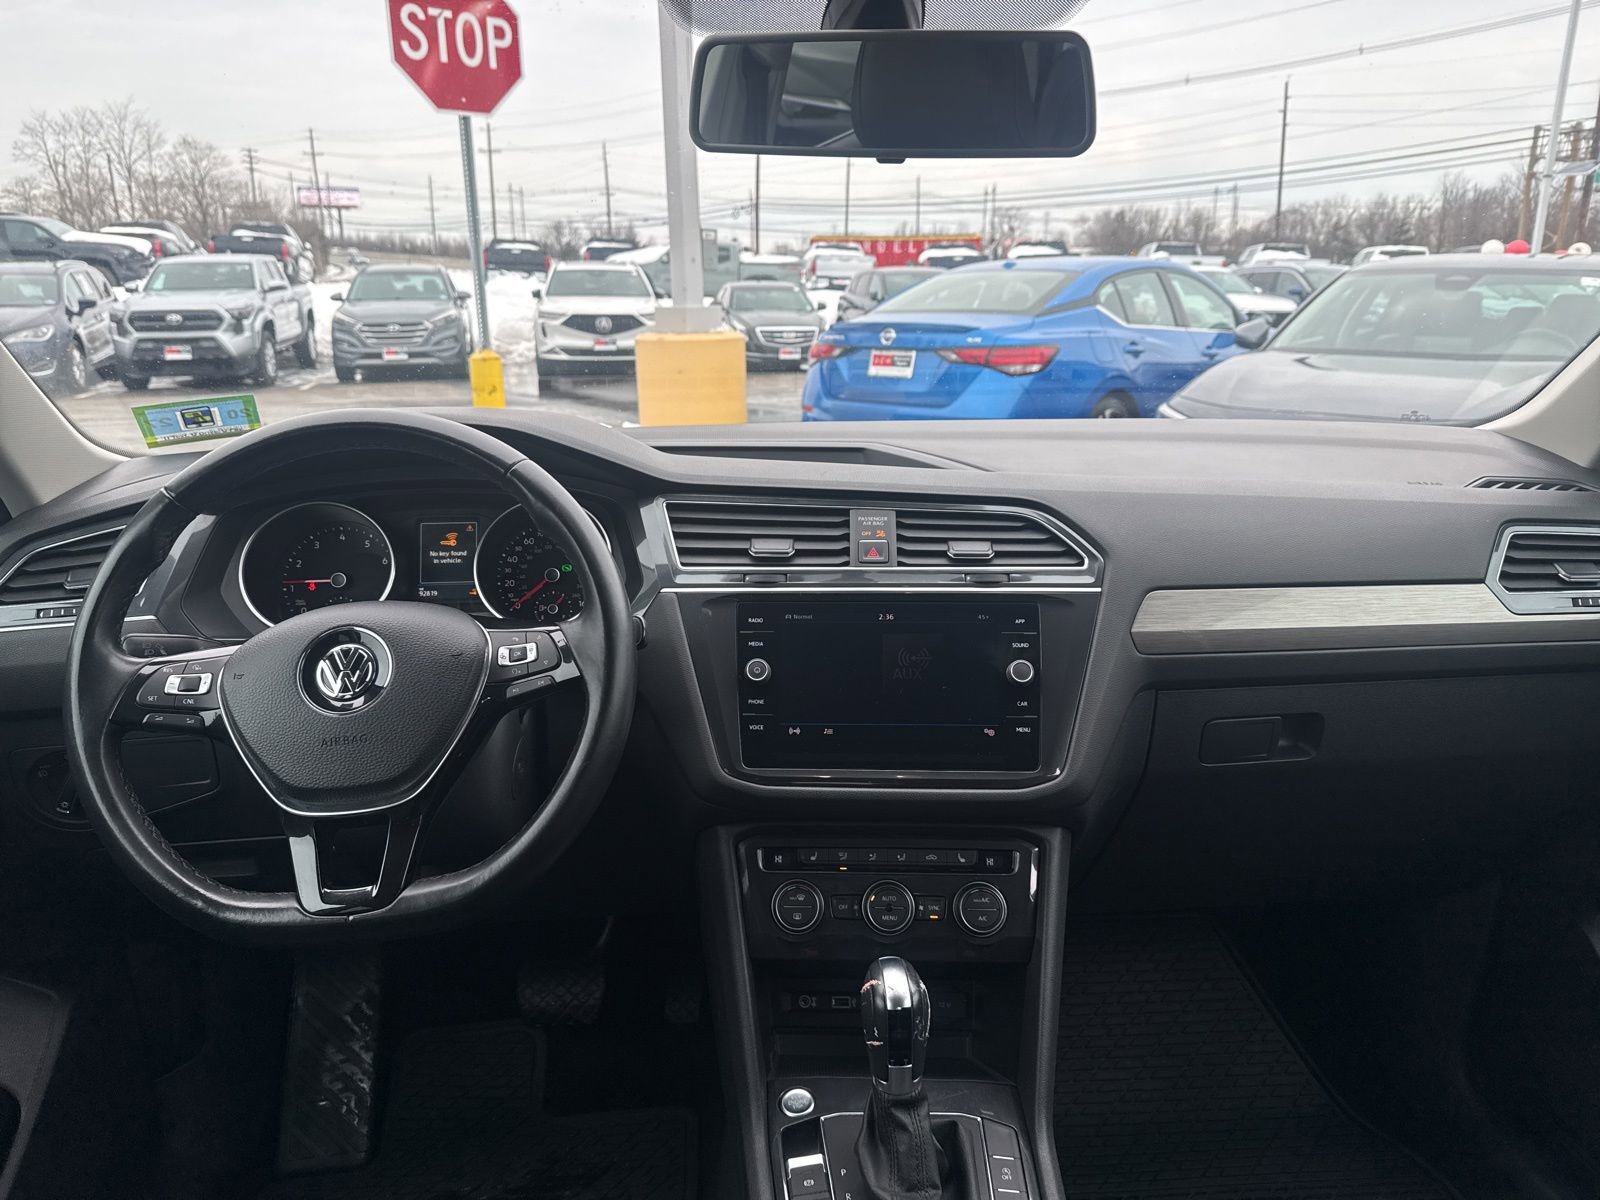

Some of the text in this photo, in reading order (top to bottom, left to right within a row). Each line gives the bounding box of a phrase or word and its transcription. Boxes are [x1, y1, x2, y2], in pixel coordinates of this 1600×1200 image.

[400, 2, 513, 70] STOP
[313, 541, 320, 549] 3
[364, 540, 371, 548] 5
[523, 537, 535, 545] 60
[382, 557, 388, 565] 6
[506, 555, 519, 563] 40
[295, 560, 302, 568] 2
[504, 579, 516, 587] 20
[290, 585, 295, 593] 1
[878, 613, 895, 621] 2:36
[892, 668, 923, 680] AUX
[320, 734, 368, 748] AIRBAG
[985, 857, 994, 866] HI
[840, 1168, 847, 1177] P
[845, 1192, 852, 1200] R
